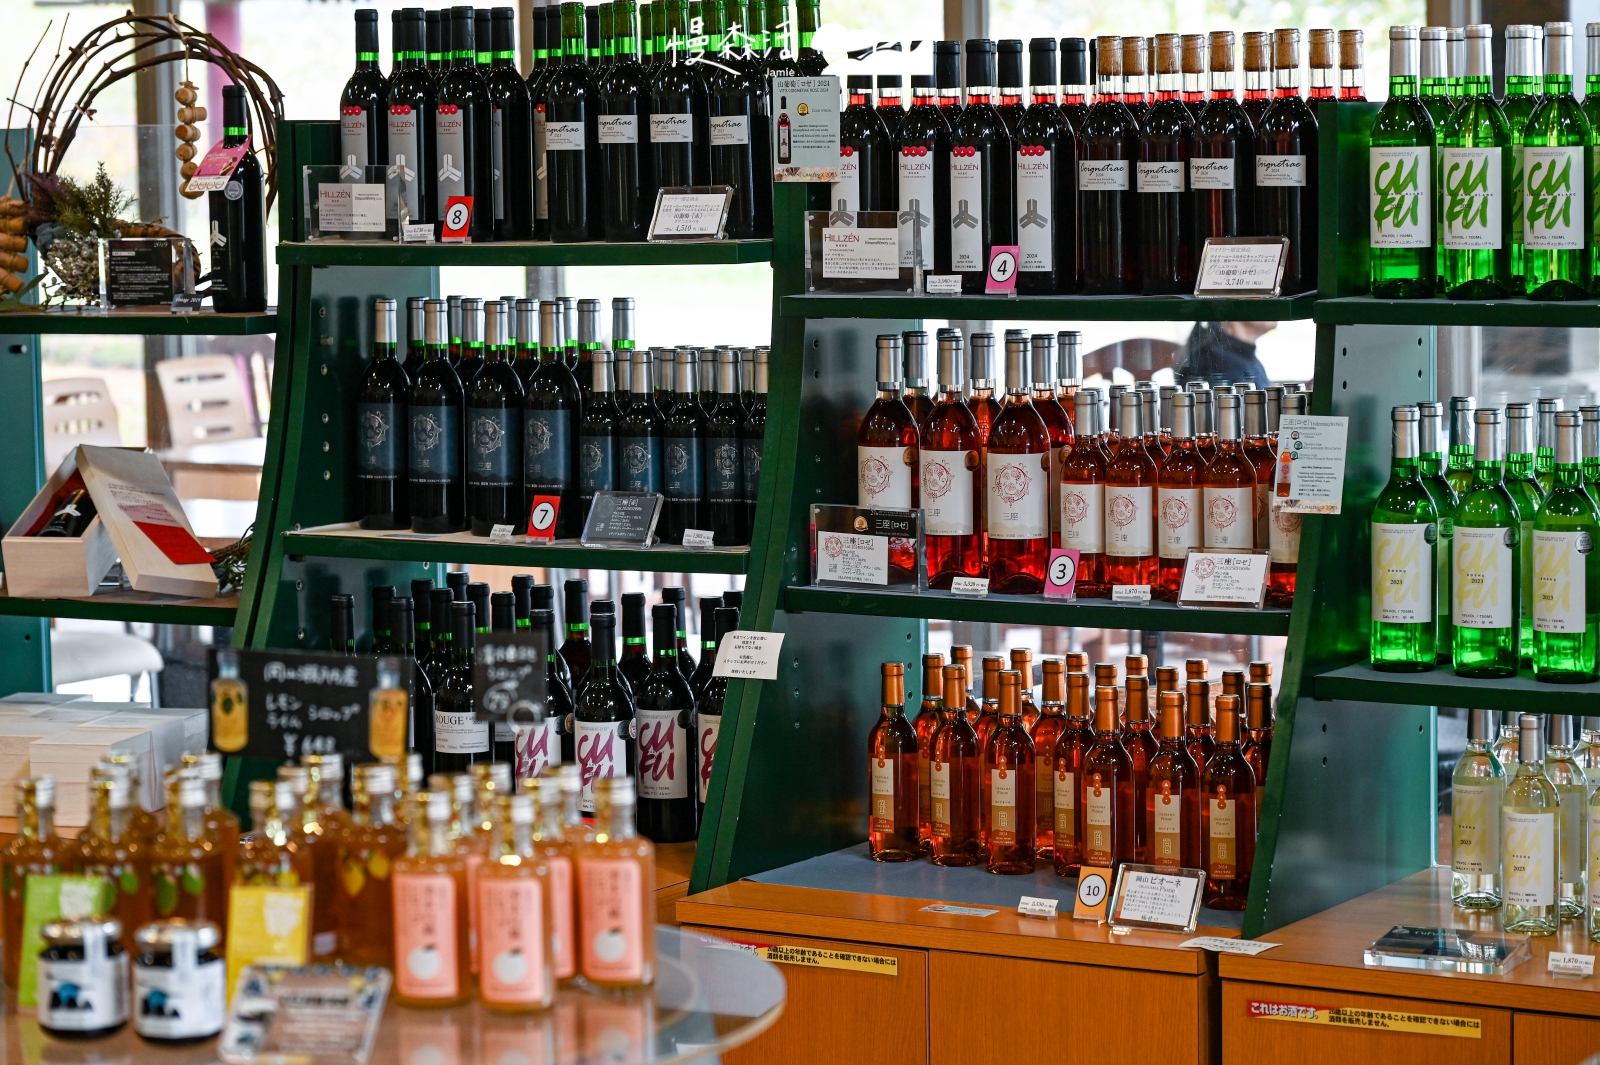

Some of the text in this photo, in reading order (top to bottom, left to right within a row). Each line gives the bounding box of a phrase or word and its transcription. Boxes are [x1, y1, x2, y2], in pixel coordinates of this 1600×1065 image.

[452, 210, 462, 225] 8
[824, 232, 860, 242] HILLZÉN
[997, 259, 1008, 276] 4
[1225, 278, 1245, 287] 3,740
[540, 509, 549, 524] 7
[1003, 512, 1019, 521] 三座
[1067, 530, 1080, 539] 三座
[1114, 534, 1128, 542] 三座
[1167, 535, 1181, 544] 三座
[1214, 535, 1228, 544] 三座
[1216, 557, 1252, 567] 三座[ロゼ]
[1055, 563, 1067, 580] 3
[638, 717, 675, 752] CU
[577, 729, 614, 765] CU
[701, 728, 718, 757] C
[1136, 875, 1182, 888] 岡山 ピオーネ
[1085, 884, 1100, 897] 10
[766, 945, 897, 966] 20歳以上の年齢であることを確認できない場合には
[766, 953, 820, 965] 酒類を販売しません。
[1562, 956, 1579, 965] 1,870
[1250, 1001, 1319, 1019] これはお酒です。
[1328, 1008, 1480, 1029] 20歳以上の年齢であることを確認できない場合には
[1328, 1015, 1390, 1028] 酒類を販売しません。
